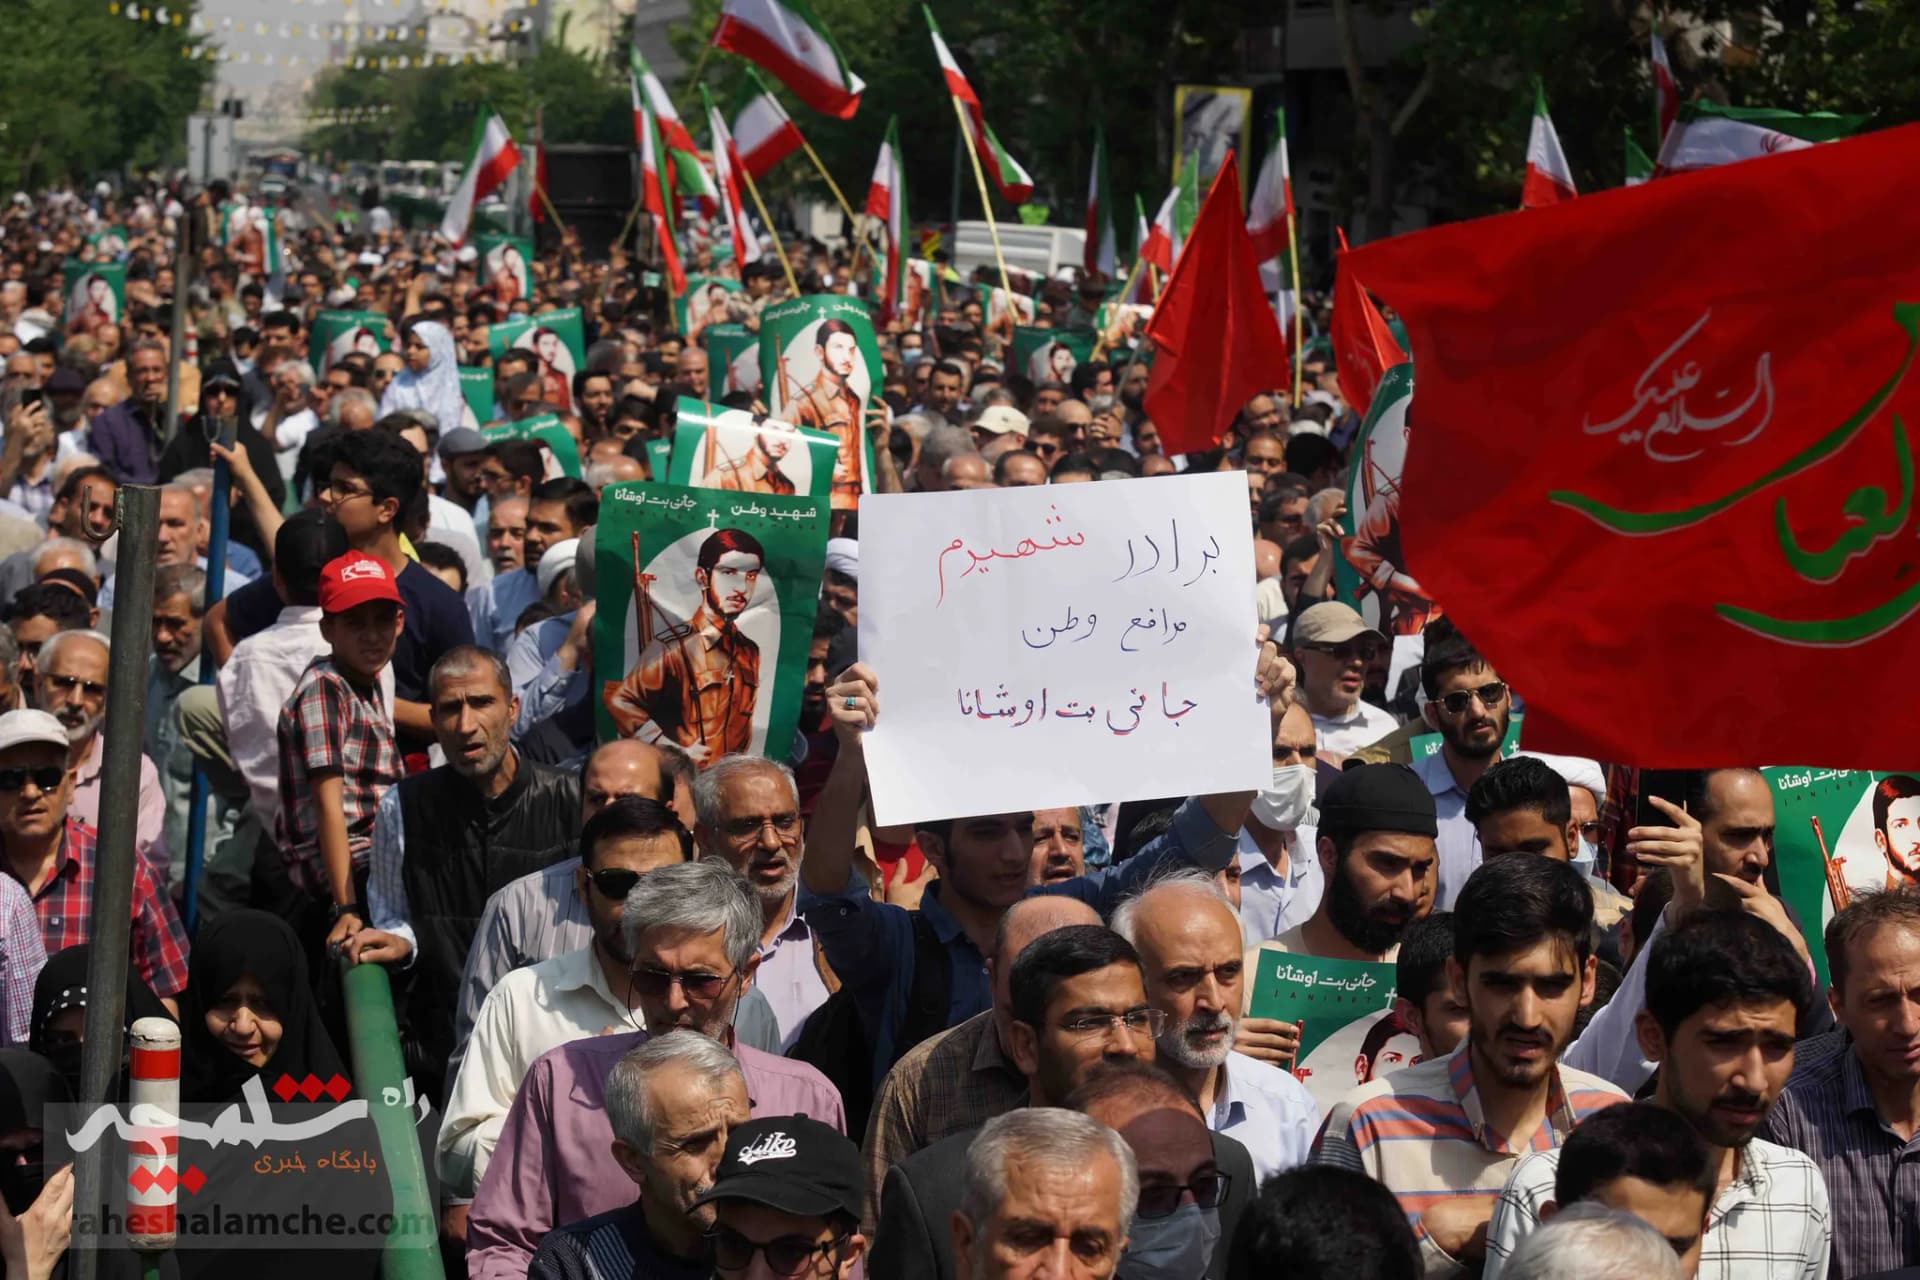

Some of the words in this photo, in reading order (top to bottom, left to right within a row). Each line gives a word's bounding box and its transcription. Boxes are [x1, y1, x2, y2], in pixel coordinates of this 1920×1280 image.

[614, 487, 646, 506] اوشانا
[669, 494, 697, 511] جانی
[731, 501, 767, 518] وطن
[769, 504, 817, 521] شهید
[1112, 517, 1221, 587] برادر
[1021, 605, 1097, 649] وطن
[1055, 702, 1096, 723] بت
[1778, 769, 1813, 791] اوشانا
[1276, 963, 1319, 988] اوشانا
[1318, 976, 1346, 991] بت
[1345, 971, 1377, 992] جانی
